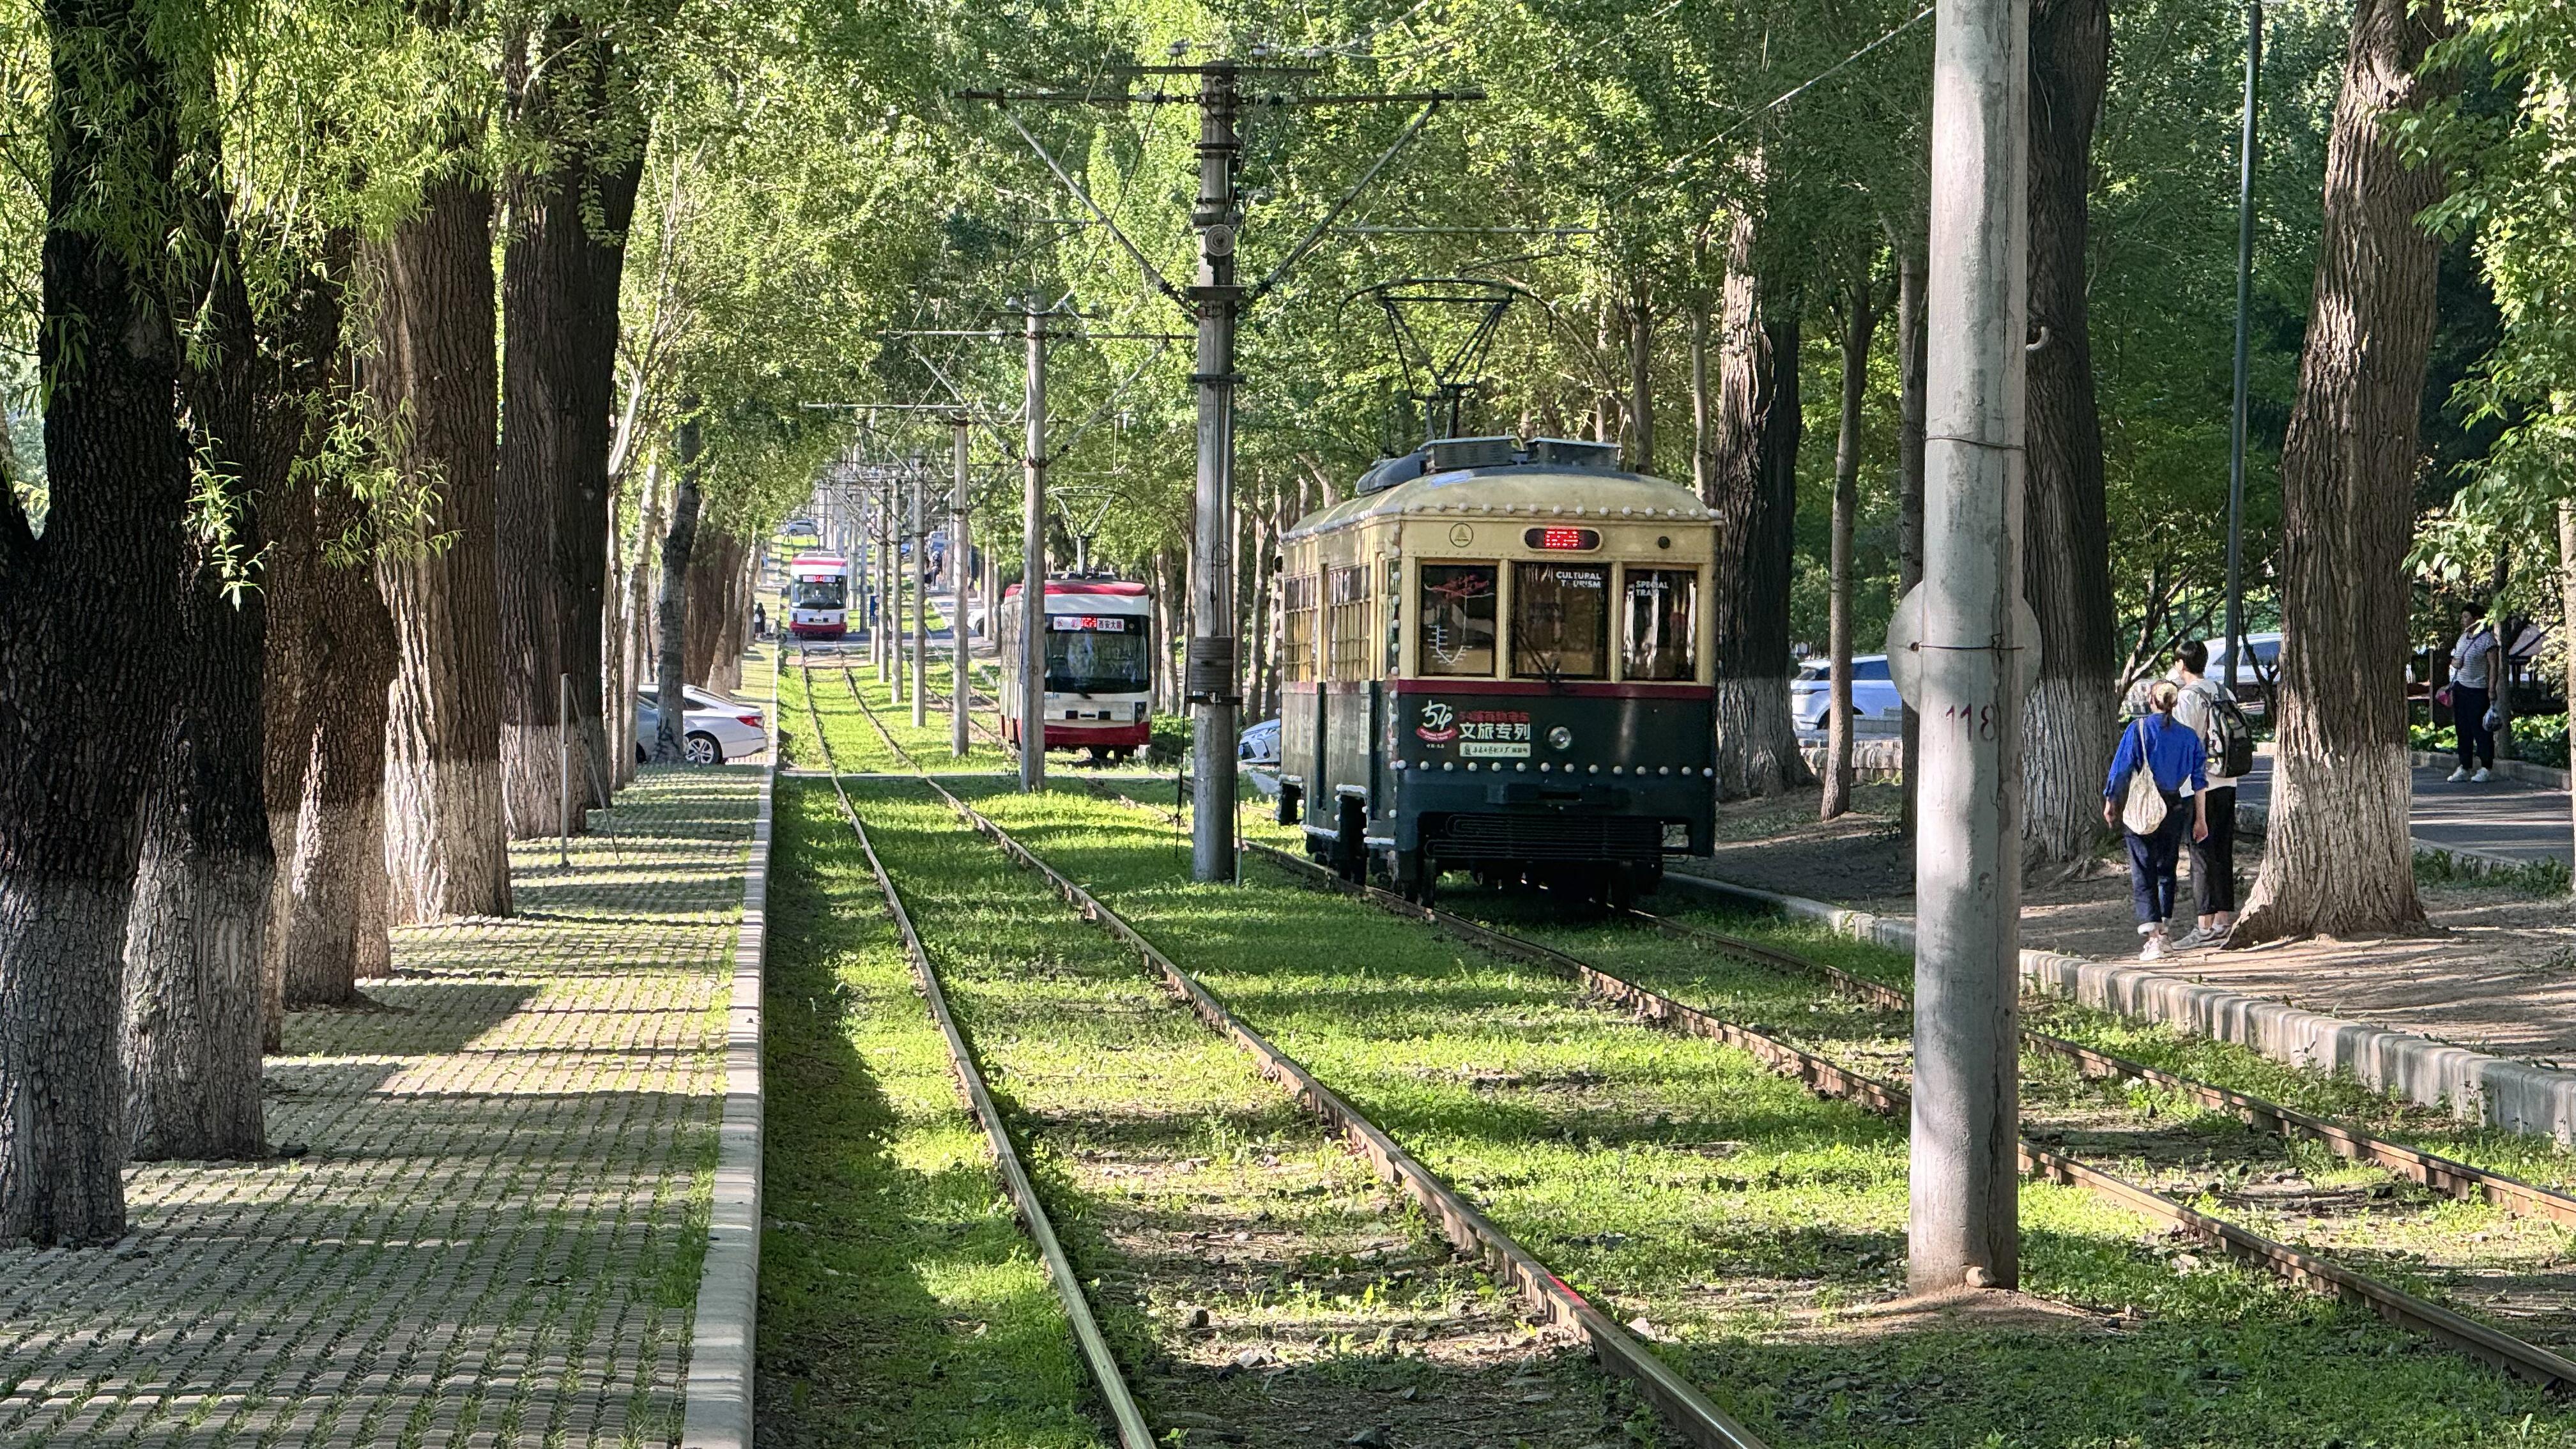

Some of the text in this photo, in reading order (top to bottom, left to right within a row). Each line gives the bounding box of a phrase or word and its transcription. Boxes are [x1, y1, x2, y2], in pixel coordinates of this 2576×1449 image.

[1556, 571, 1601, 580] CULTURAL
[1561, 579, 1601, 588] TURISM
[1946, 703, 1995, 742] 118
[1459, 722, 1531, 740] 文旅专列
